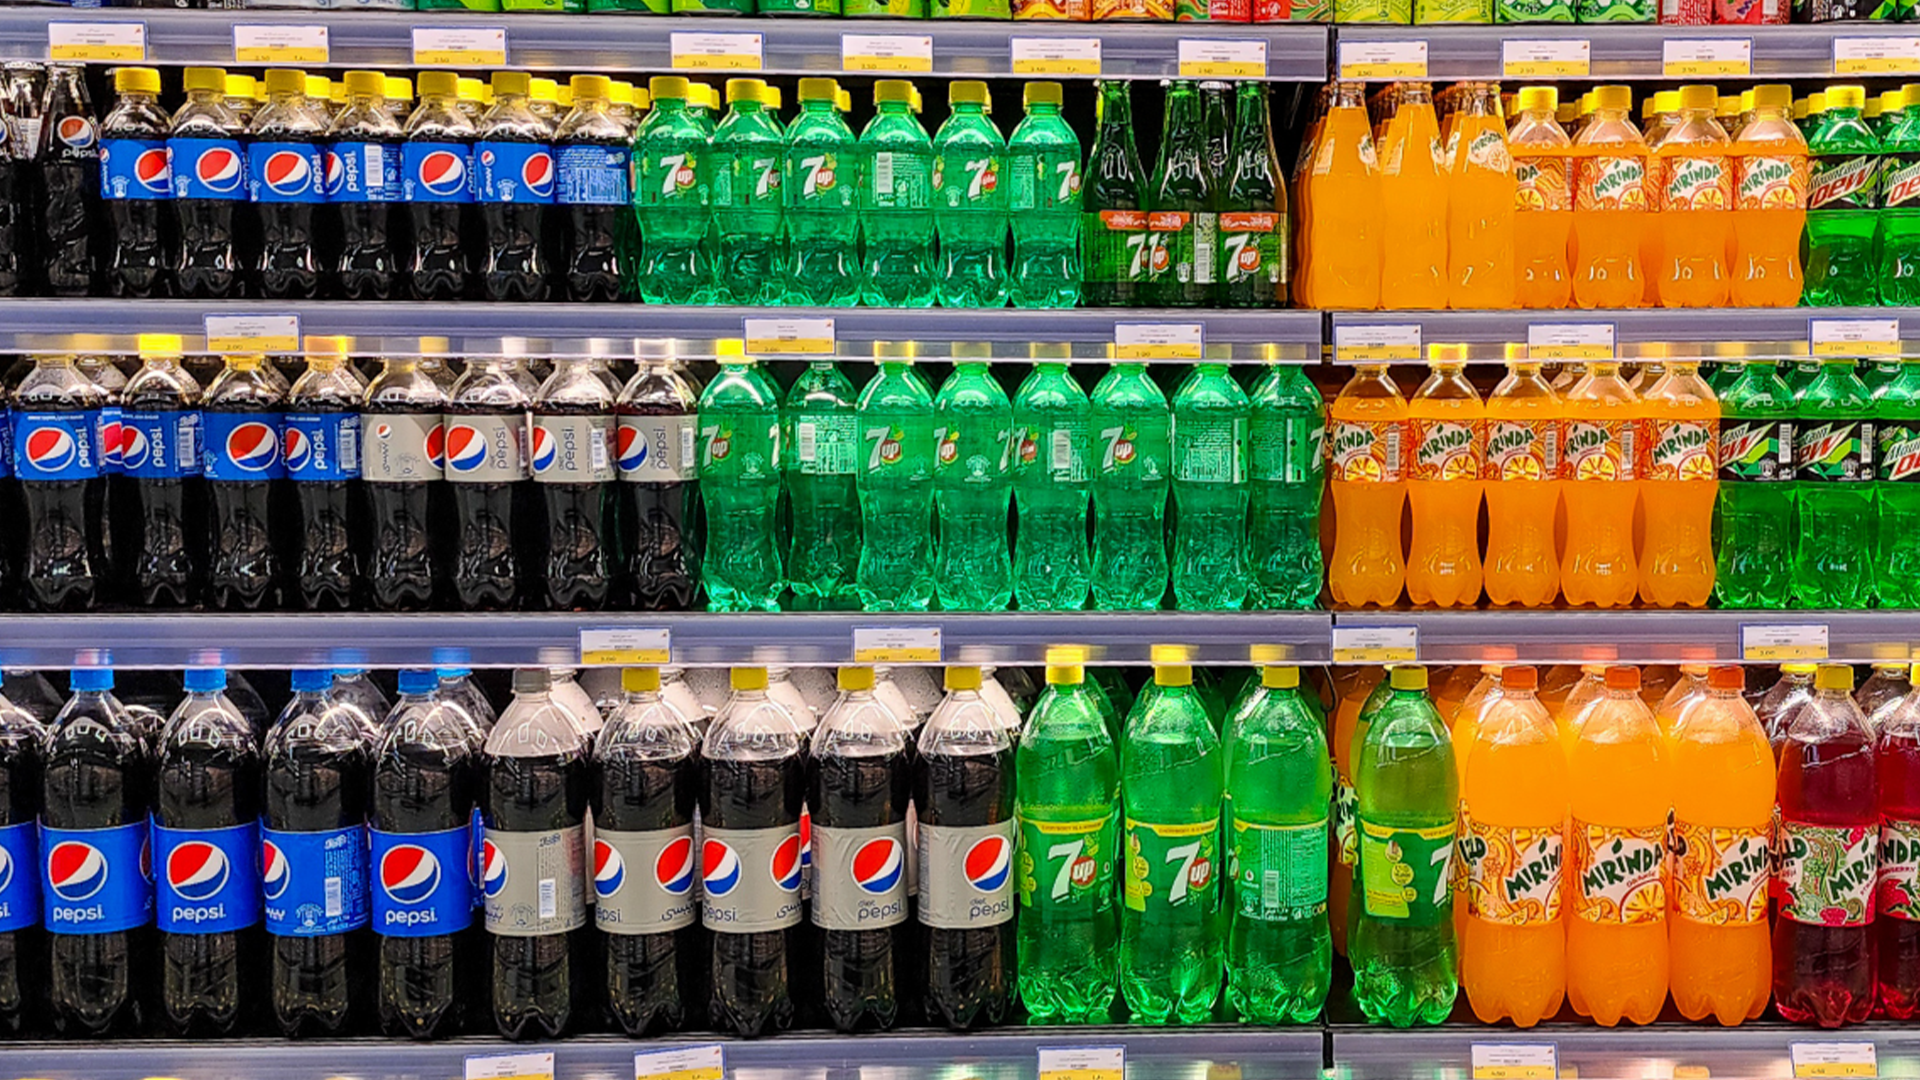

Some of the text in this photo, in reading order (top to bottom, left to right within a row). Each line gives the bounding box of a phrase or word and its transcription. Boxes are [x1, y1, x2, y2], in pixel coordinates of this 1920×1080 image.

[311, 154, 323, 193] pepsi
[345, 151, 358, 192] pepsi
[1669, 161, 1720, 198] MIRINDA
[1741, 159, 1792, 195] MIRINDA
[76, 428, 91, 468] pepsi
[150, 428, 166, 468] pepsi
[312, 429, 327, 470] pepsi
[494, 426, 510, 469] pepsi
[562, 425, 578, 471] pepsi
[653, 425, 669, 470] pepsi
[866, 426, 901, 471] 7up
[1101, 426, 1133, 472] 7up
[1419, 423, 1473, 462] MIRINDA
[1653, 424, 1711, 464] MIRINDA
[1048, 839, 1096, 902] 7up
[1166, 842, 1211, 904] 7up
[1583, 838, 1662, 896] MIRINDA
[54, 904, 104, 924] pepsi
[173, 903, 226, 924] pepsi
[385, 907, 437, 926] pepsi
[858, 899, 902, 921] pepsi
[970, 897, 1009, 921] pepsi
